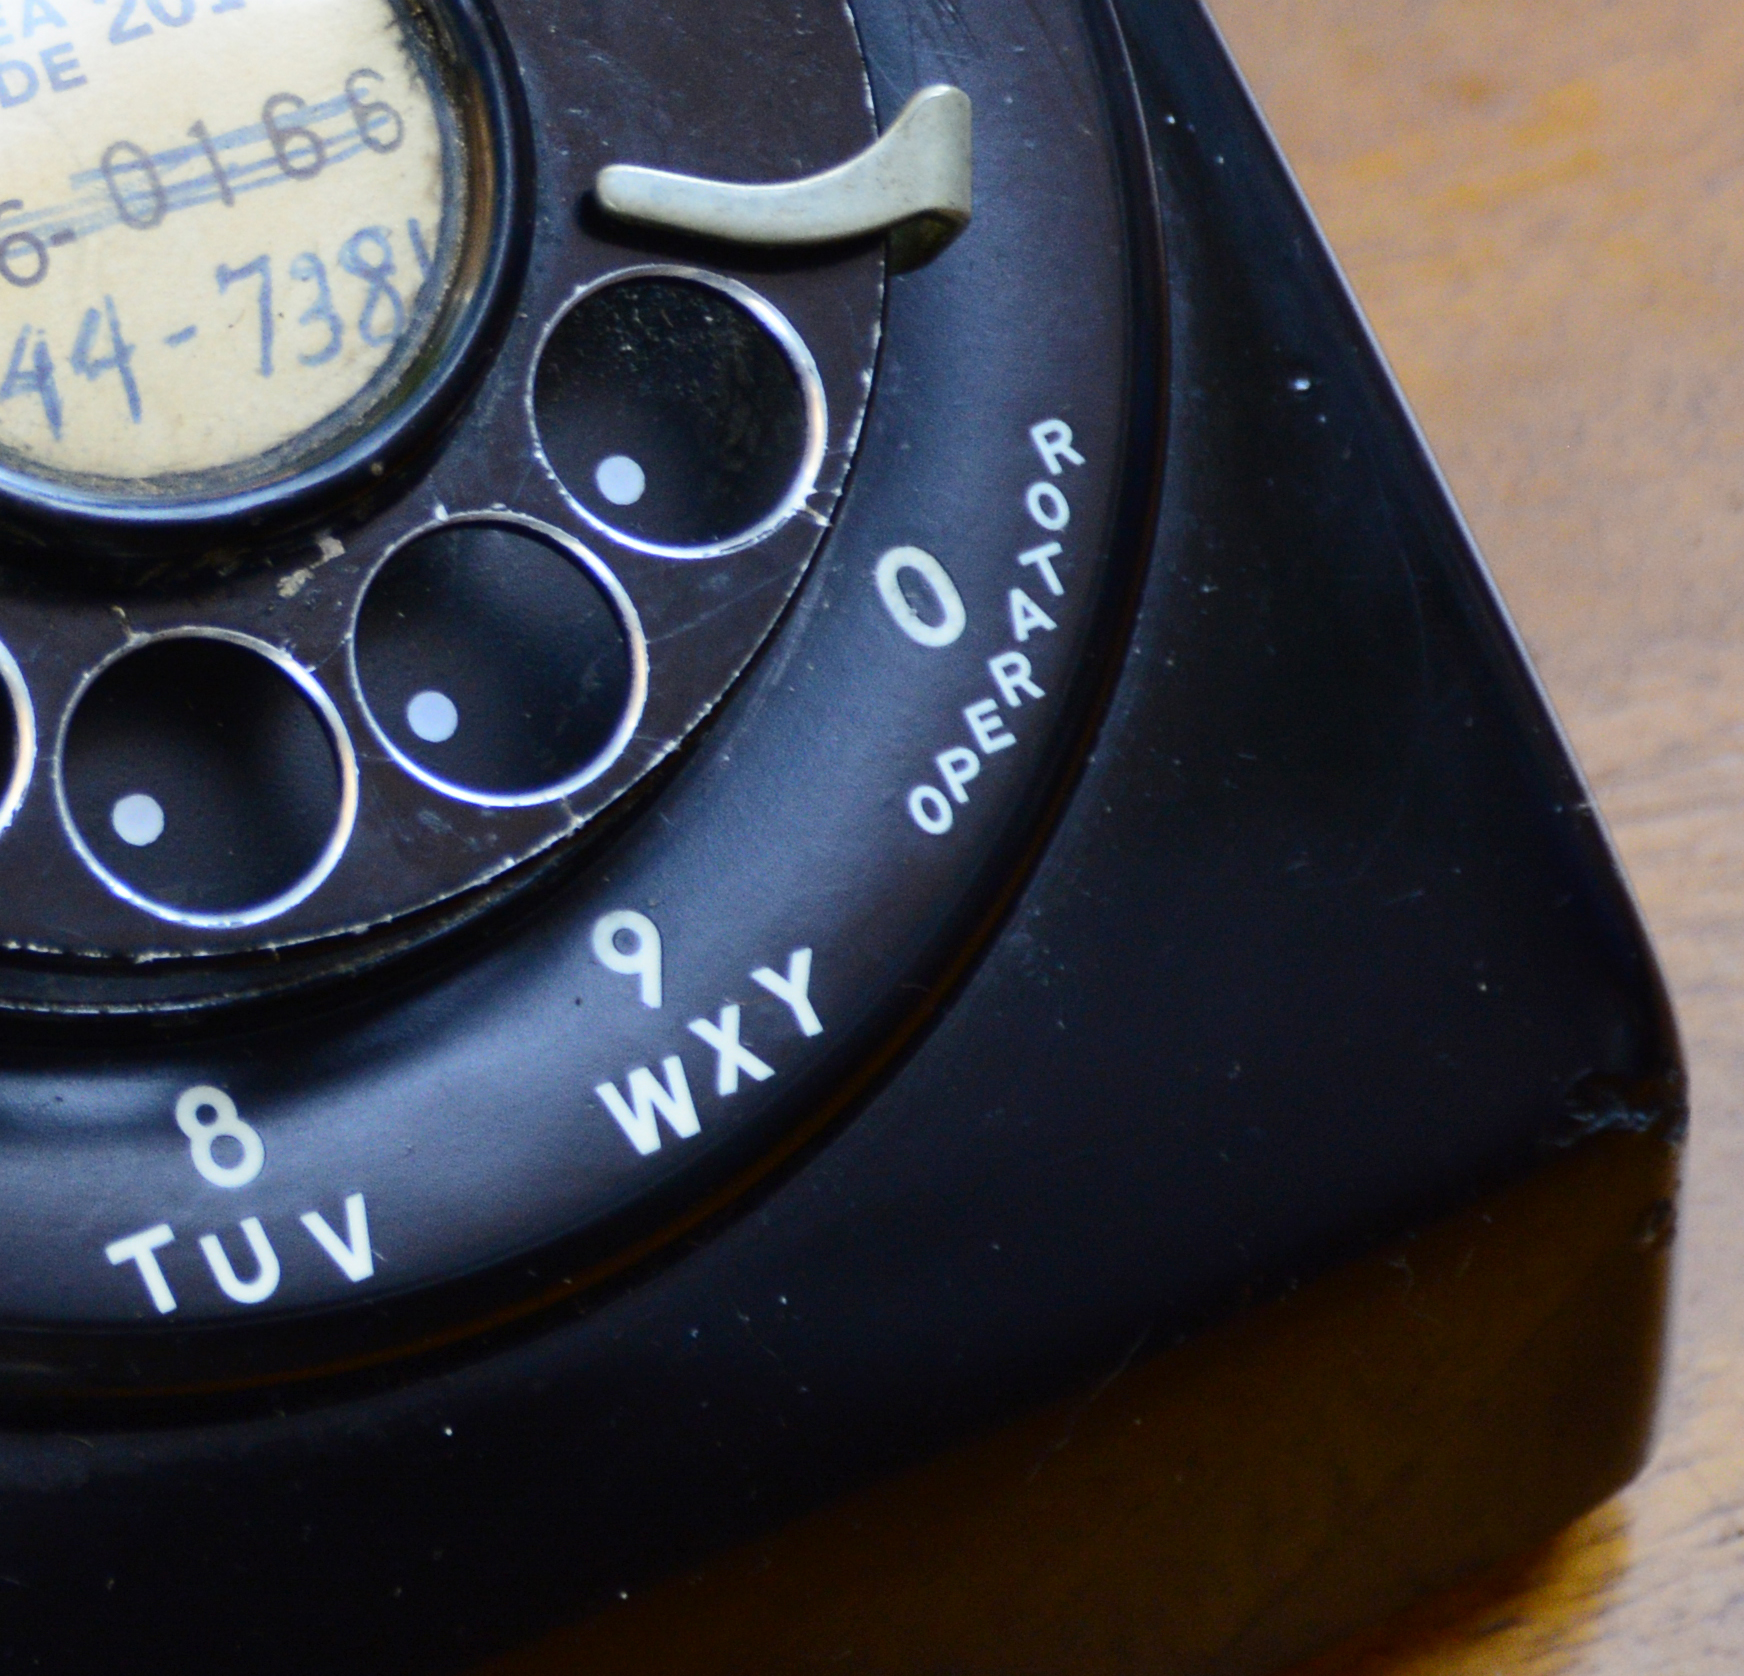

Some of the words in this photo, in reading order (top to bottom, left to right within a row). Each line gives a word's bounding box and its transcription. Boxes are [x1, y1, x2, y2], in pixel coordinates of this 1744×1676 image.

[907, 418, 1086, 835] OPERATOR
[590, 909, 663, 1011] 9
[594, 947, 825, 1156] WXY
[175, 1085, 265, 1192] 8
[104, 1192, 375, 1314] TUV
